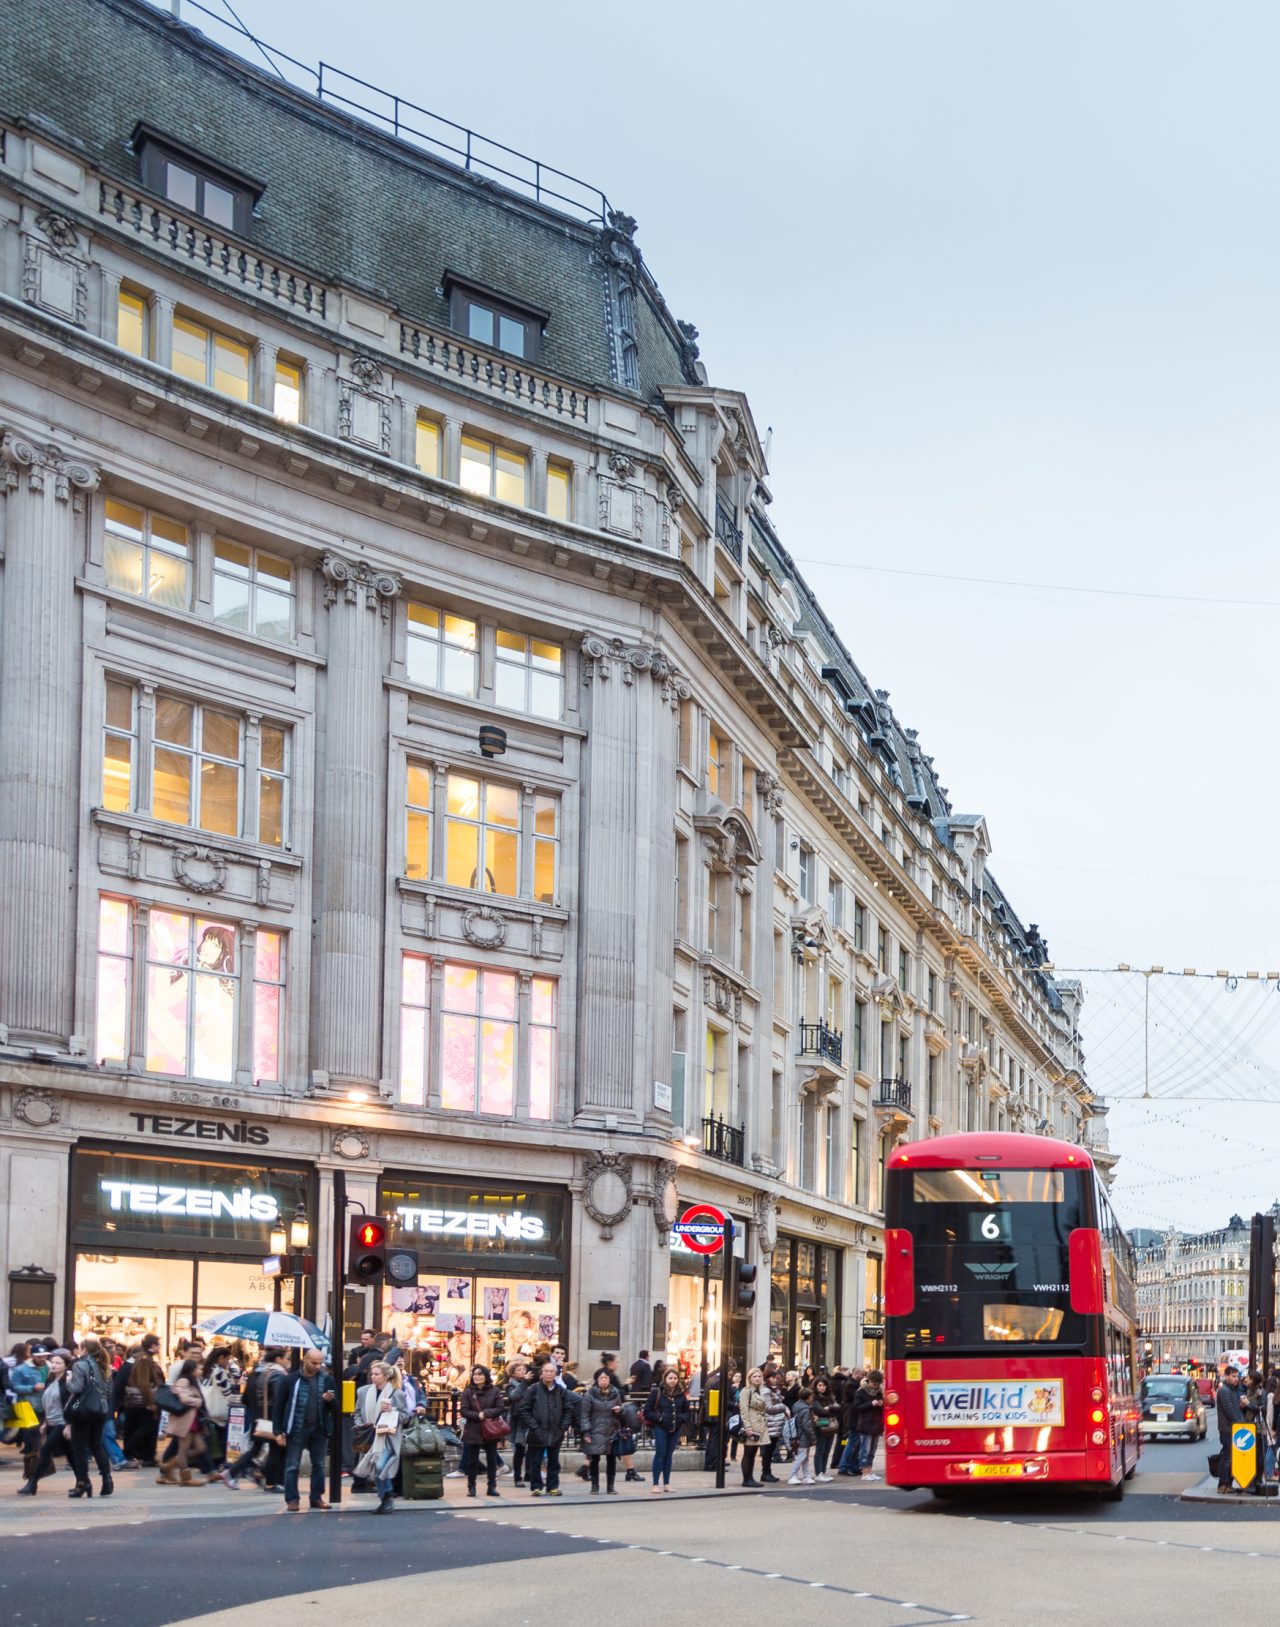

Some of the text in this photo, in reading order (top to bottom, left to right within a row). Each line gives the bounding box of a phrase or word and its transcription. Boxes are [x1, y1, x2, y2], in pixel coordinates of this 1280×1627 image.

[981, 1213, 1000, 1239] 6
[975, 1273, 1010, 1281] WRIGHT
[921, 1284, 958, 1292] VWH2112
[1032, 1284, 1070, 1292] VWH2112
[930, 1387, 1023, 1410] wellkid
[931, 1411, 1027, 1420] VITAMINS FOR KIDS
[914, 1438, 951, 1446] VOLVO
